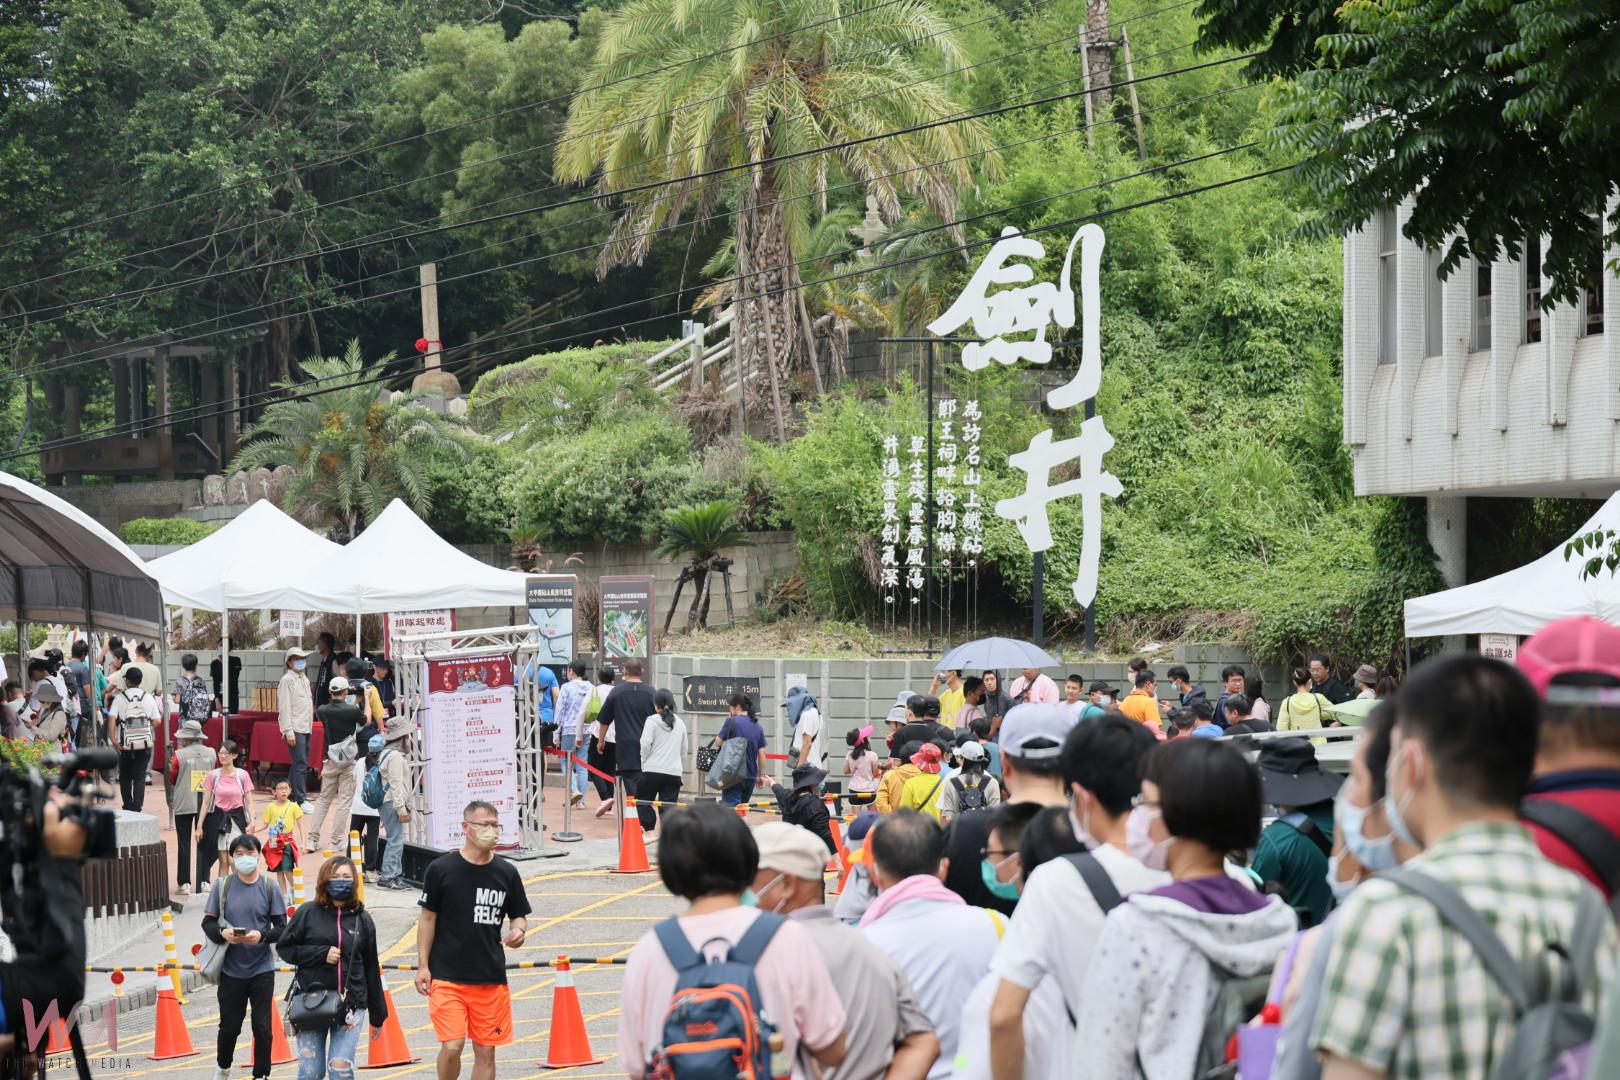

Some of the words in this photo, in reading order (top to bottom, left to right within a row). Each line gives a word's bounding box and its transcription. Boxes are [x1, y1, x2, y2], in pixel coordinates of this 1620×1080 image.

[395, 616, 446, 628] 排隊起點處
[1484, 647, 1513, 659] 救護站
[475, 887, 507, 908] MON
